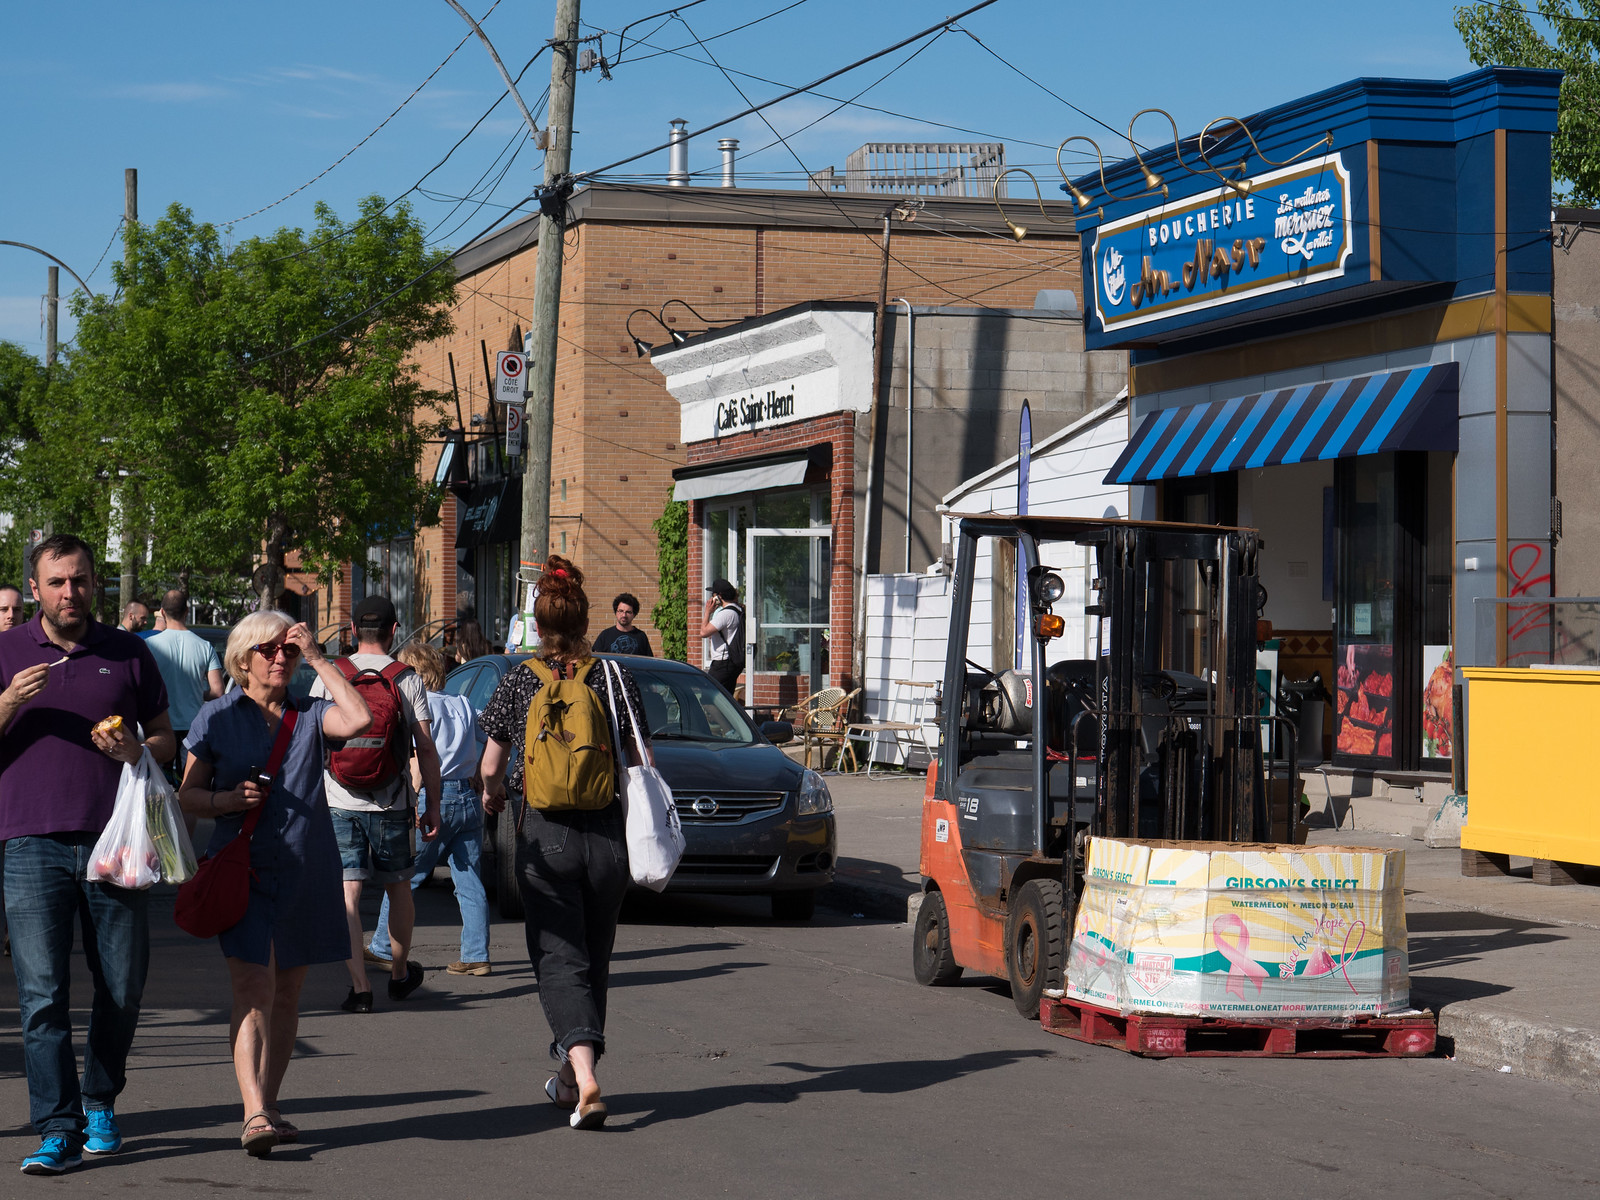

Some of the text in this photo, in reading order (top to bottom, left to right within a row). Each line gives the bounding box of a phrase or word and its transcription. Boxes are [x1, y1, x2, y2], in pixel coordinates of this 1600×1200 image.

[1149, 199, 1255, 247] BOUCHERIE
[503, 386, 519, 394] DROIT
[1100, 676, 1108, 763] TOYOTA
[965, 797, 979, 813] 18
[1225, 876, 1359, 892] GIBSON'S SELECT
[1231, 900, 1288, 909] WATERMELON
